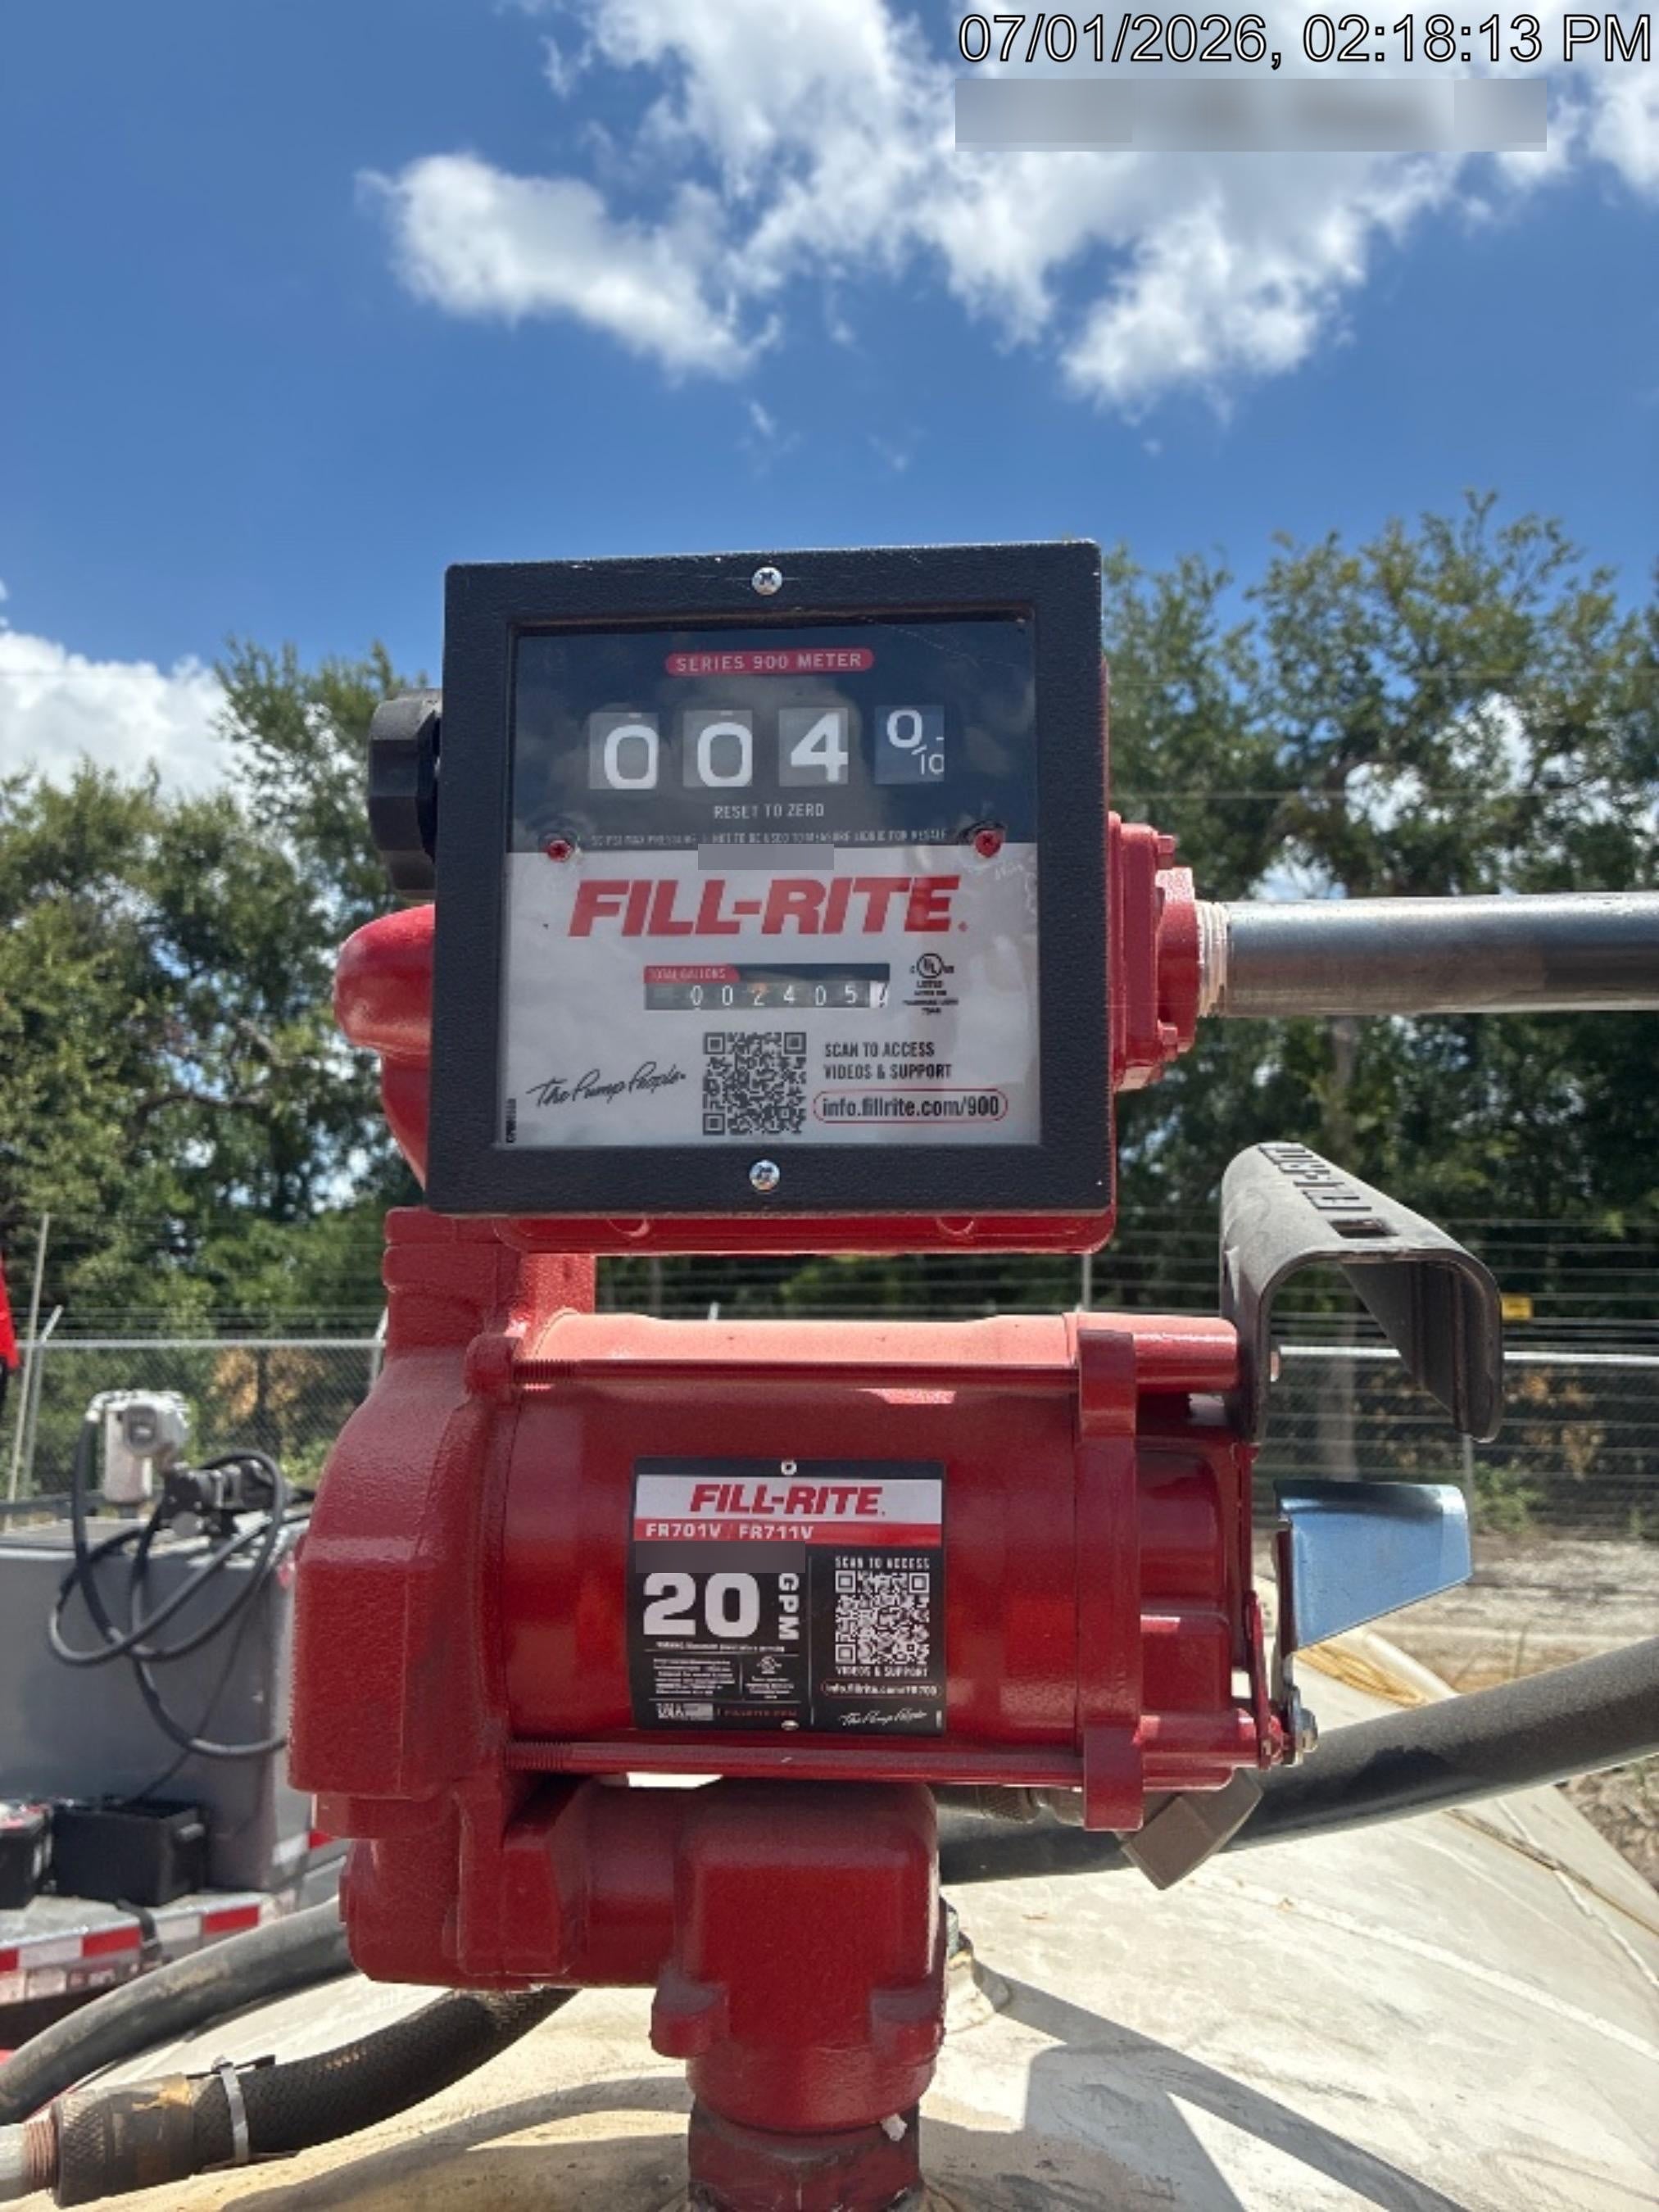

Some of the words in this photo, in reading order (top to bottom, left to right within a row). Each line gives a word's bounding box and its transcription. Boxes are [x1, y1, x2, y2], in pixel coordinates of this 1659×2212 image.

[676, 656, 745, 673] SERIES
[753, 655, 787, 670] 900
[797, 652, 861, 669] METER
[714, 805, 759, 819] RESET
[764, 803, 782, 818] TO
[788, 802, 825, 818] ZERO
[568, 875, 961, 937] FILL-RITE
[824, 1041, 859, 1058] SCAN
[863, 1041, 879, 1057] TO
[882, 1040, 936, 1058] ACCESS
[823, 1064, 873, 1080] VIDEOS
[877, 1065, 886, 1079] &
[890, 1063, 952, 1080] SUPPORT
[526, 1077, 571, 1108] The
[571, 1068, 626, 1104] Pump
[822, 1095, 999, 1117] info.fillrite.com/900
[690, 1483, 883, 1515] FILL-RITE
[646, 1523, 722, 1539] FR701V
[739, 1525, 814, 1540] FR711V
[835, 1556, 864, 1570] SCAN
[869, 1557, 882, 1570] TO
[886, 1557, 931, 1571] ACCESS
[643, 1572, 759, 1638] 20
[778, 1572, 800, 1640] GPM
